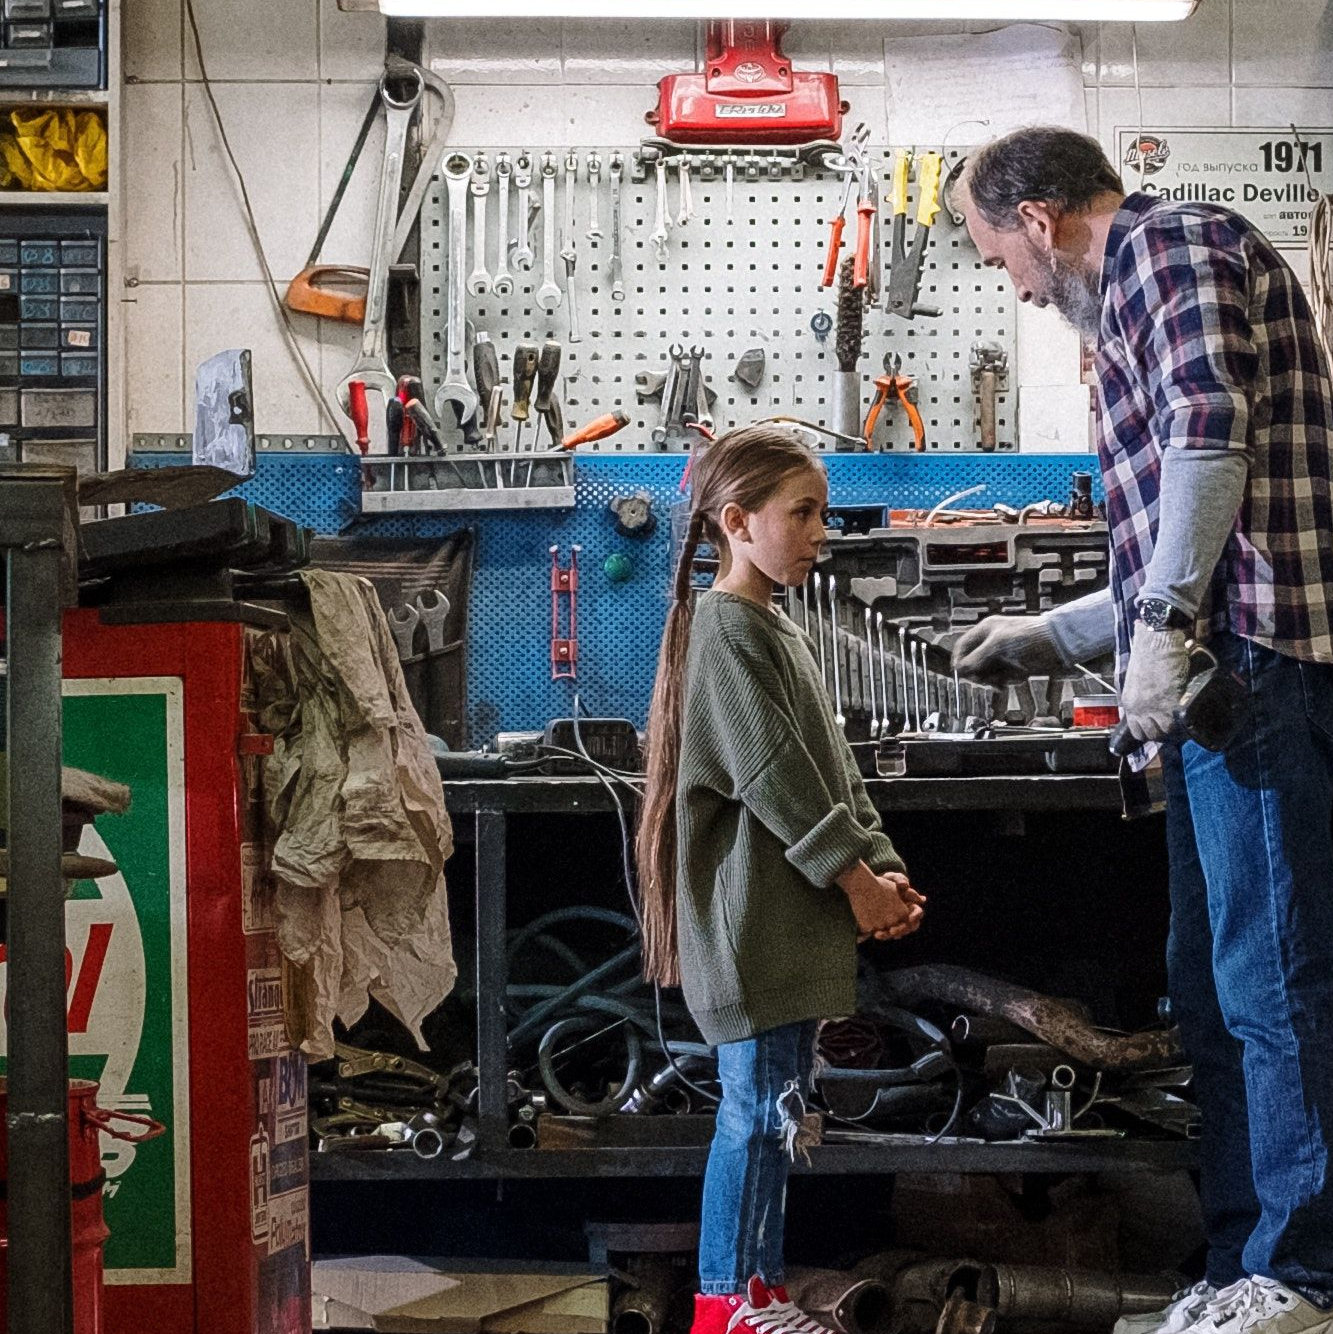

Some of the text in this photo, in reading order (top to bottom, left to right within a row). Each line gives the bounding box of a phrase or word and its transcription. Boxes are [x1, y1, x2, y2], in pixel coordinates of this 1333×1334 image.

[1203, 162, 1259, 174] выпуска
[1259, 141, 1323, 173] 1971
[1243, 183, 1321, 203] Deville
